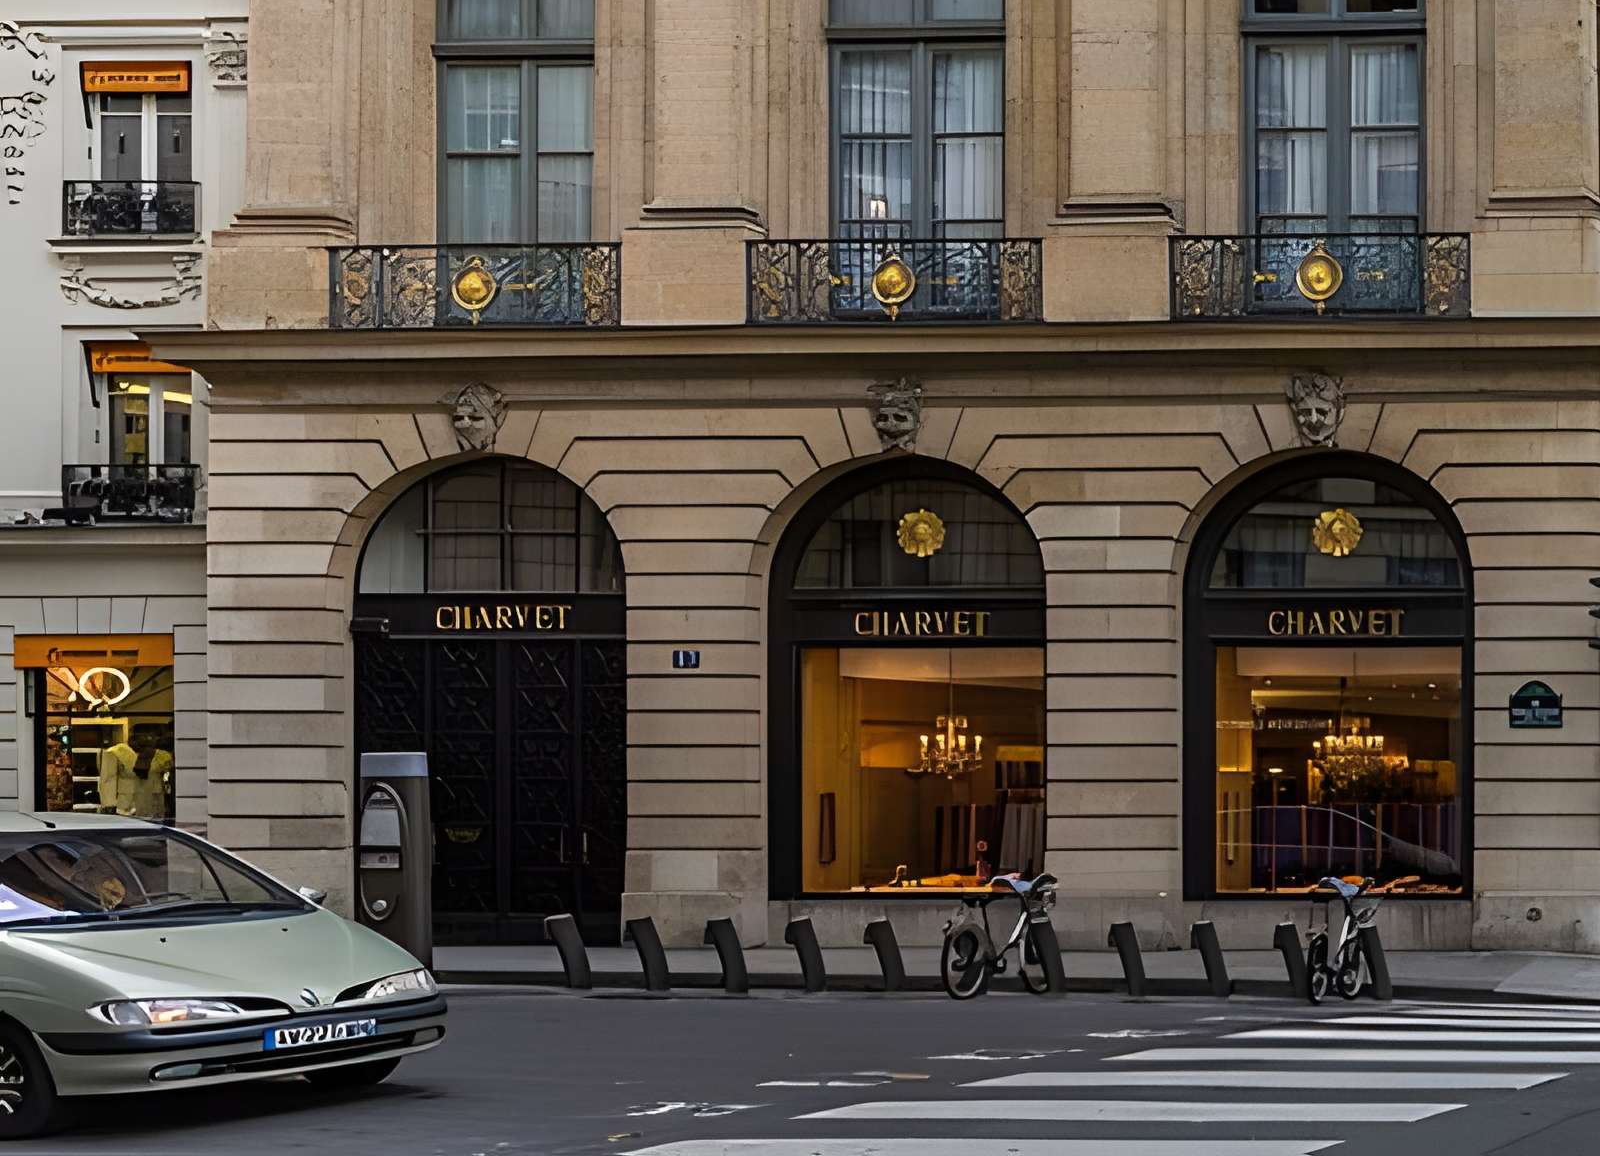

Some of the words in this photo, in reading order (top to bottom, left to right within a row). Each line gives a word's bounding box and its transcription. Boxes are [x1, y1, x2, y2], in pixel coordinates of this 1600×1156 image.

[436, 605, 572, 630] CHARVET
[854, 611, 992, 636] CHARVET
[1268, 609, 1405, 636] CHARVET
